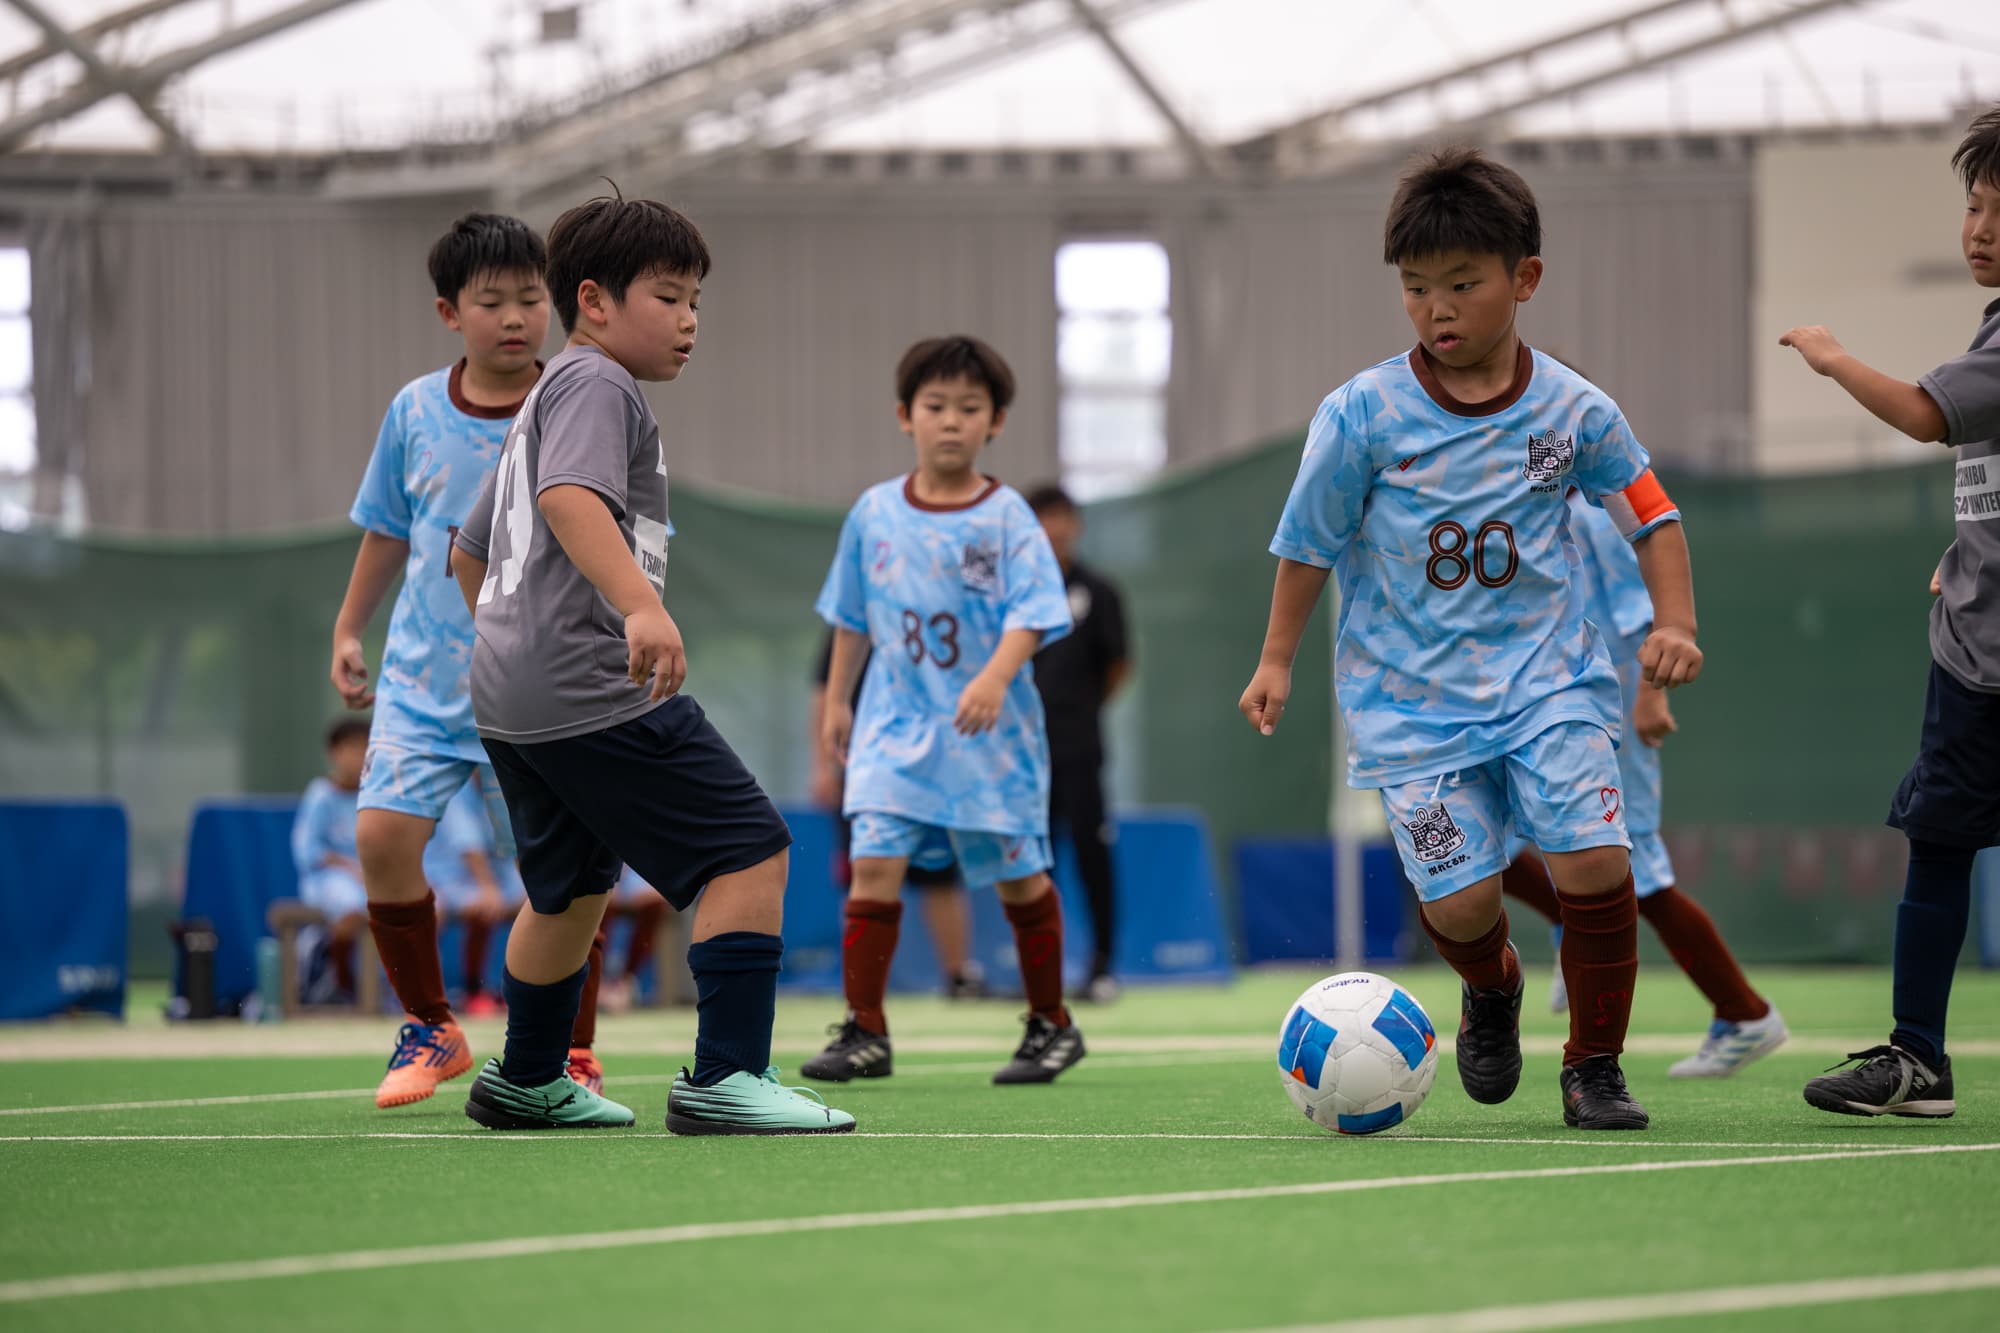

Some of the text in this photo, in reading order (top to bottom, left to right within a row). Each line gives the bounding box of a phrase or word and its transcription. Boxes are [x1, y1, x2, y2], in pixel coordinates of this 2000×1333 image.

[1426, 520, 1519, 591] 80
[903, 609, 960, 669] 83
[1323, 978, 1370, 991] molten
